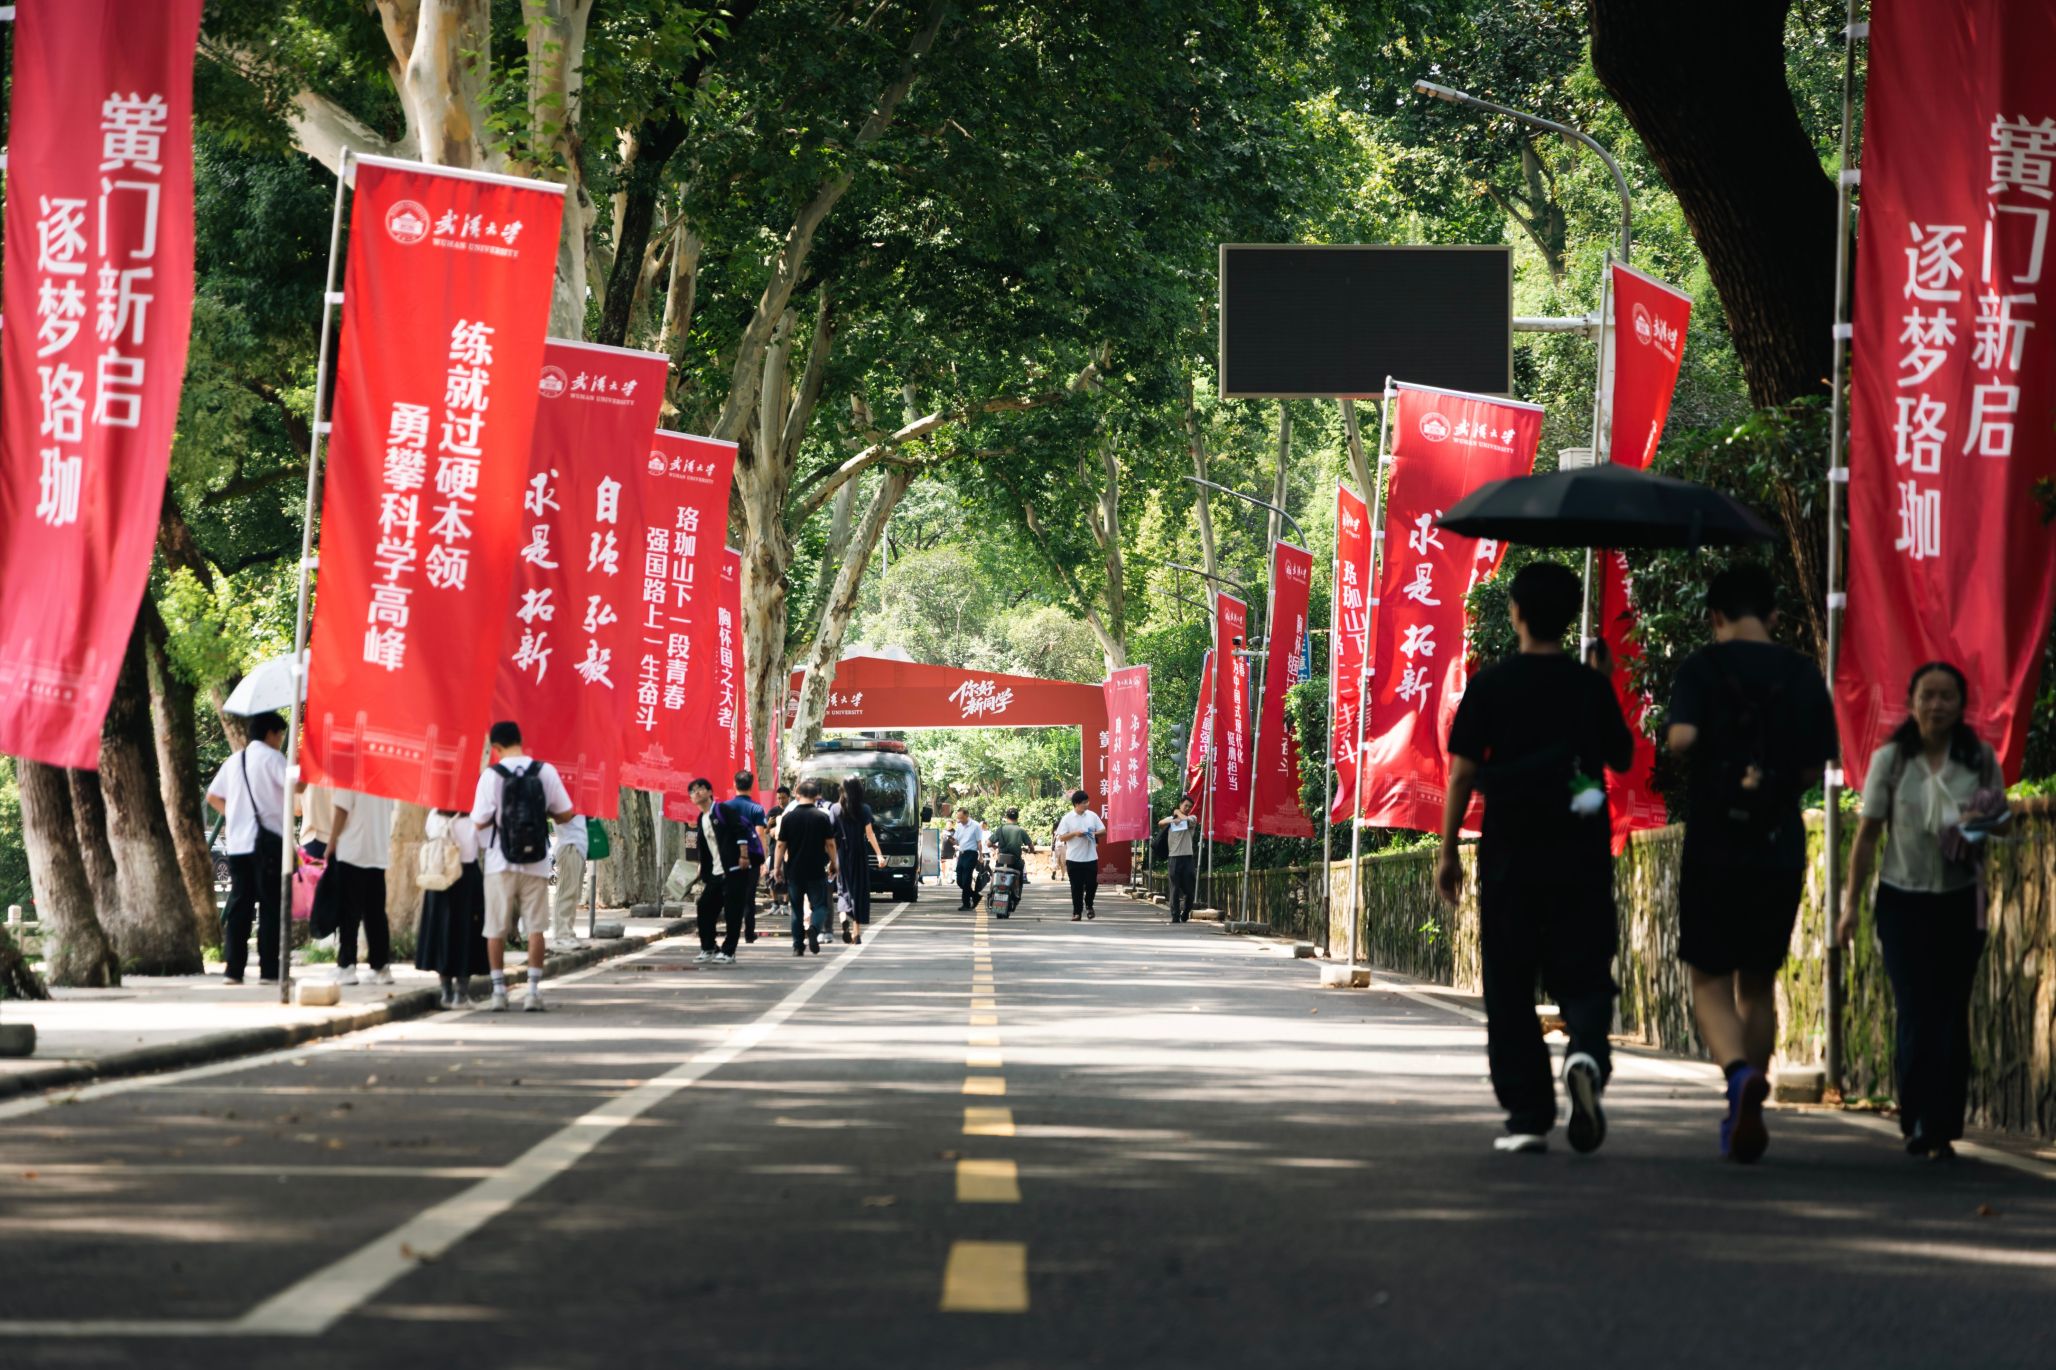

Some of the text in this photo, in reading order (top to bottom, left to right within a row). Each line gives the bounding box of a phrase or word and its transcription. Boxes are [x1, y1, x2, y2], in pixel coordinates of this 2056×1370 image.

[432, 238, 520, 258] WUHAN UNIVERSITY
[36, 195, 88, 527] 逐梦珞珈
[426, 319, 495, 591] 练就过硬本领
[1895, 221, 1967, 560] 逐梦珞珈
[363, 402, 431, 672] 勇攀科学高峰
[635, 527, 670, 732] 强国路上一生奋斗
[663, 506, 700, 711] 珞珈山下一段青春
[948, 680, 996, 709] 你好
[961, 687, 1016, 719] 新同学
